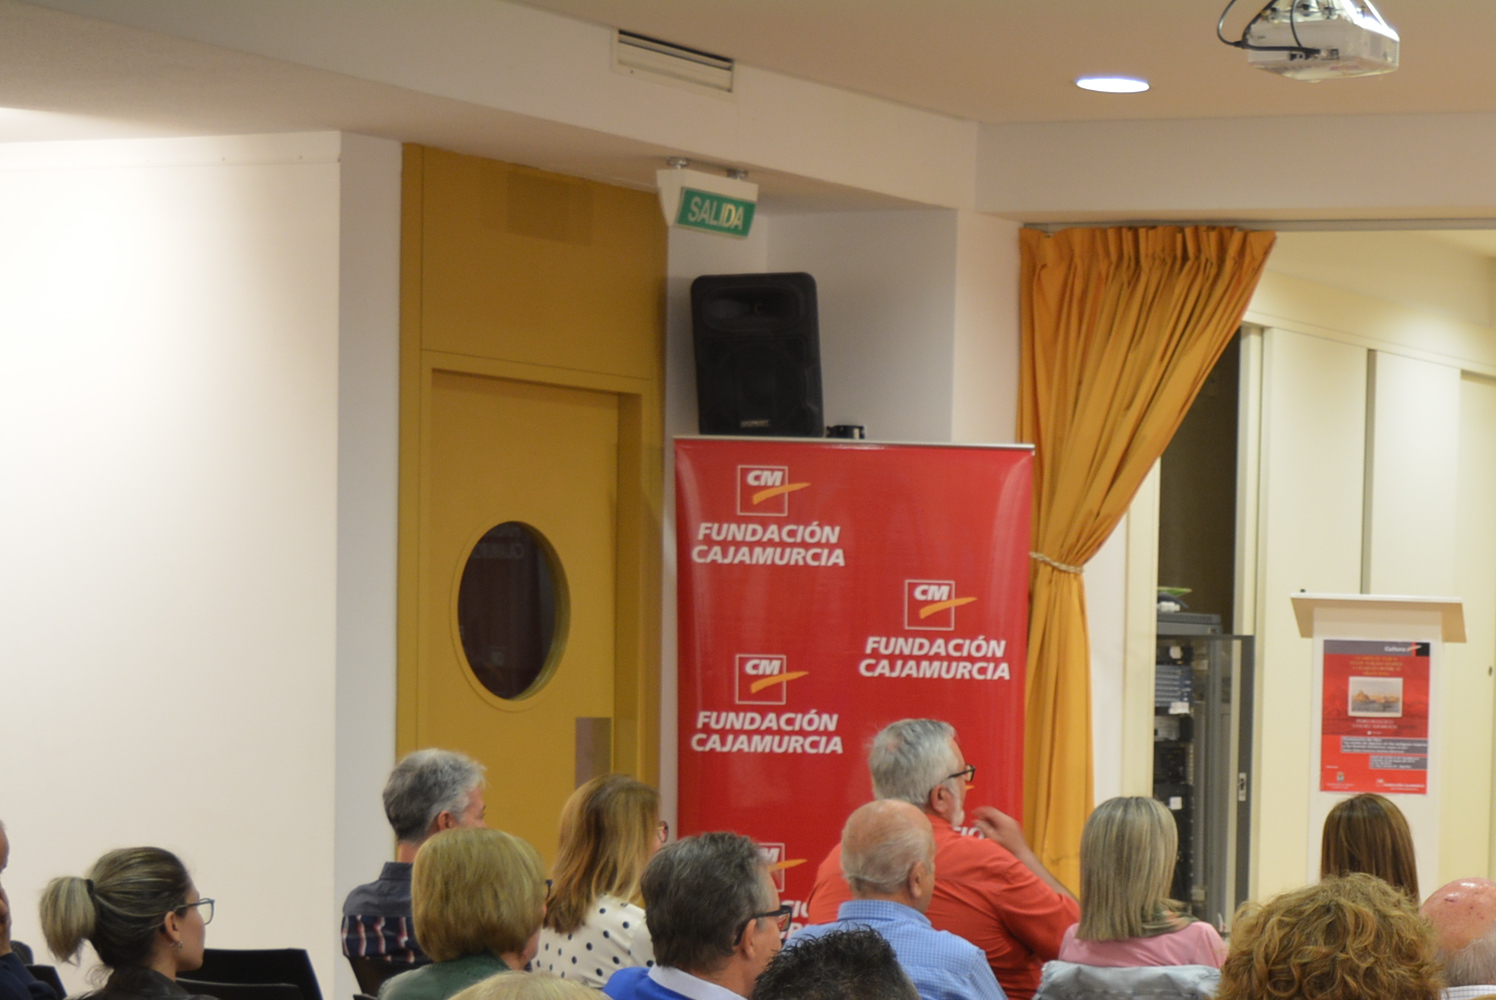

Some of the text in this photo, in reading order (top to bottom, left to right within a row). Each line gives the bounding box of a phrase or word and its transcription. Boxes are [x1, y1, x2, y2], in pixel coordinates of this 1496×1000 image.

[688, 196, 744, 230] SALIDA
[746, 470, 784, 486] CM
[697, 521, 841, 543] FUNDACIÓN
[691, 545, 845, 566] CAJAMURCIA
[913, 585, 950, 601] CM
[865, 635, 1006, 657] FUNDACIÓN
[745, 659, 782, 675] CM
[859, 659, 1010, 680] CAJAMURCIA
[696, 709, 839, 731] FUNDACIÓN
[691, 733, 843, 754] CAJAMURCIA
